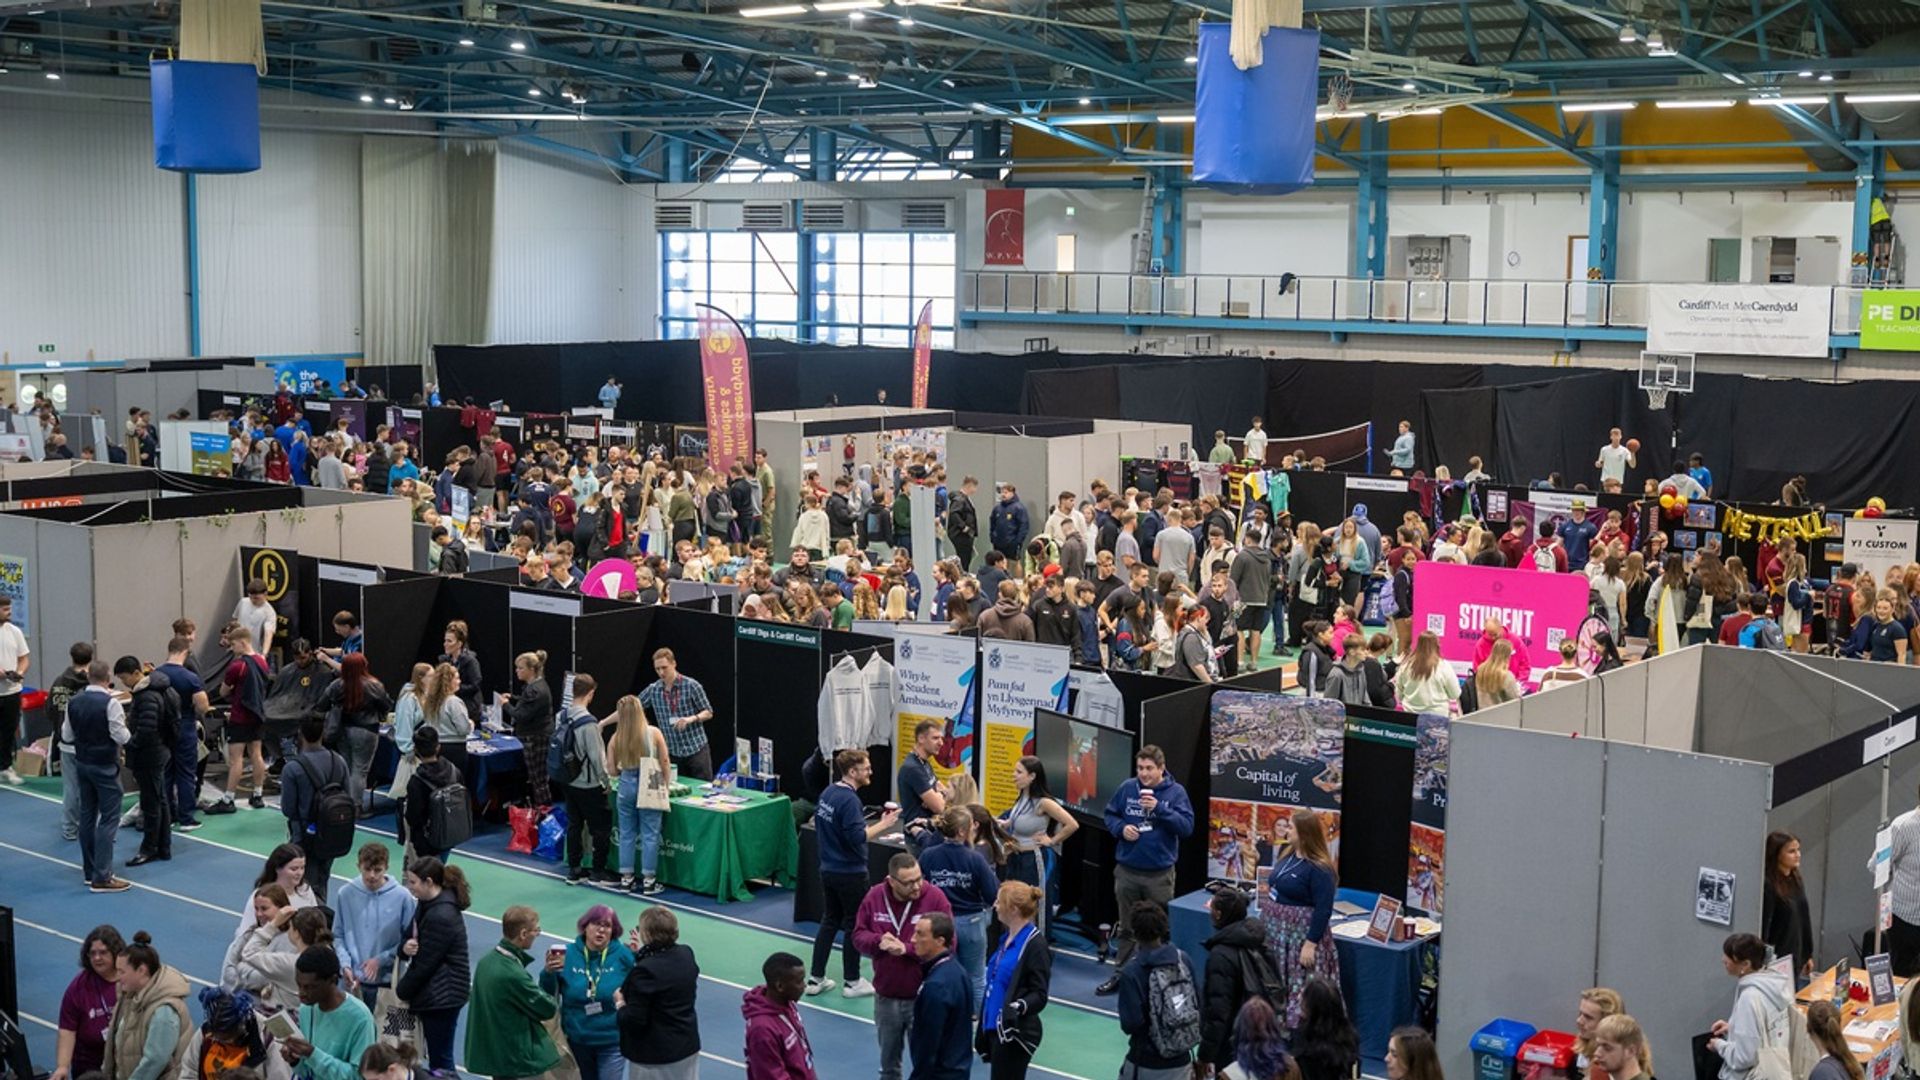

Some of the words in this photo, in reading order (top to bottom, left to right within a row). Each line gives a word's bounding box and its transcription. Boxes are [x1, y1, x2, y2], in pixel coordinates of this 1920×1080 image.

[1678, 299, 1730, 310] CardiffMet
[1733, 301, 1798, 313] MetCaerdydd
[1868, 305, 1894, 320] PE
[299, 370, 318, 381] the
[299, 380, 315, 393] gu
[1865, 540, 1908, 549] CUSTOM
[1459, 602, 1535, 638] STUDENT
[899, 669, 920, 682] Why
[920, 671, 931, 682] be
[899, 683, 904, 691] a
[905, 682, 940, 695] Student
[987, 678, 1009, 690] Pam
[1009, 679, 1025, 692] fod
[899, 693, 958, 710] Ambassador?
[987, 693, 999, 704] yn
[1000, 692, 1054, 708] Llysgennad
[987, 704, 1033, 720] Myfyrwyr
[1236, 766, 1283, 783] Capital
[1284, 772, 1299, 787] of
[1262, 784, 1301, 802] living
[1432, 793, 1446, 808] Pr
